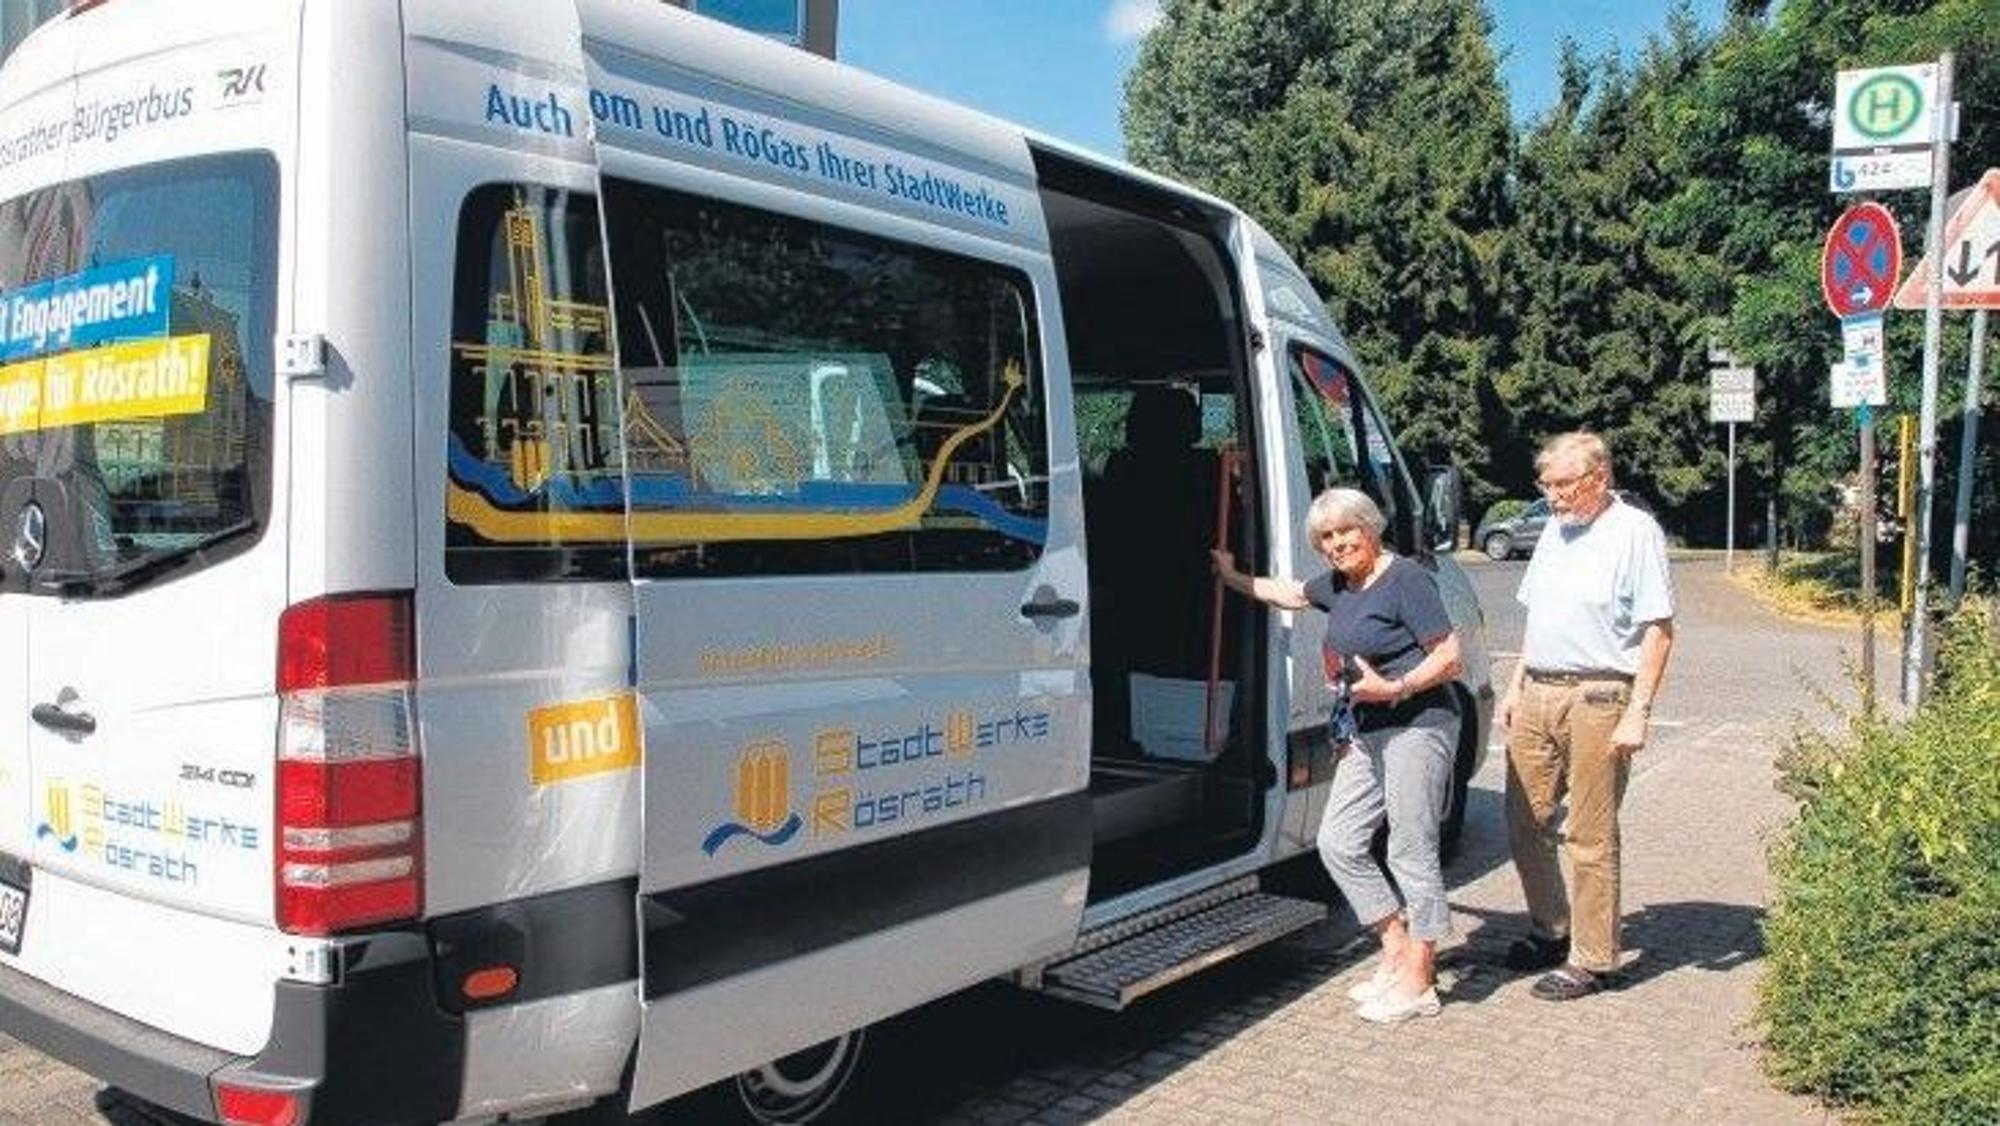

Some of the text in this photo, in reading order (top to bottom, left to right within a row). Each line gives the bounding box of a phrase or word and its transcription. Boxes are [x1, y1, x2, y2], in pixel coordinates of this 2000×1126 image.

[71, 85, 194, 143] Bürgerbus
[1868, 87, 1901, 125] H
[485, 84, 572, 137] Auch
[653, 106, 713, 148] und
[720, 117, 810, 172] RöGas
[815, 142, 876, 190] Ihrer
[883, 163, 1010, 226] StadtWerke
[12, 264, 160, 348] Engagement
[82, 343, 201, 404] Rösrath!
[543, 701, 621, 765] und
[816, 709, 1050, 776] StadtWerke
[813, 771, 986, 837] Rösrath
